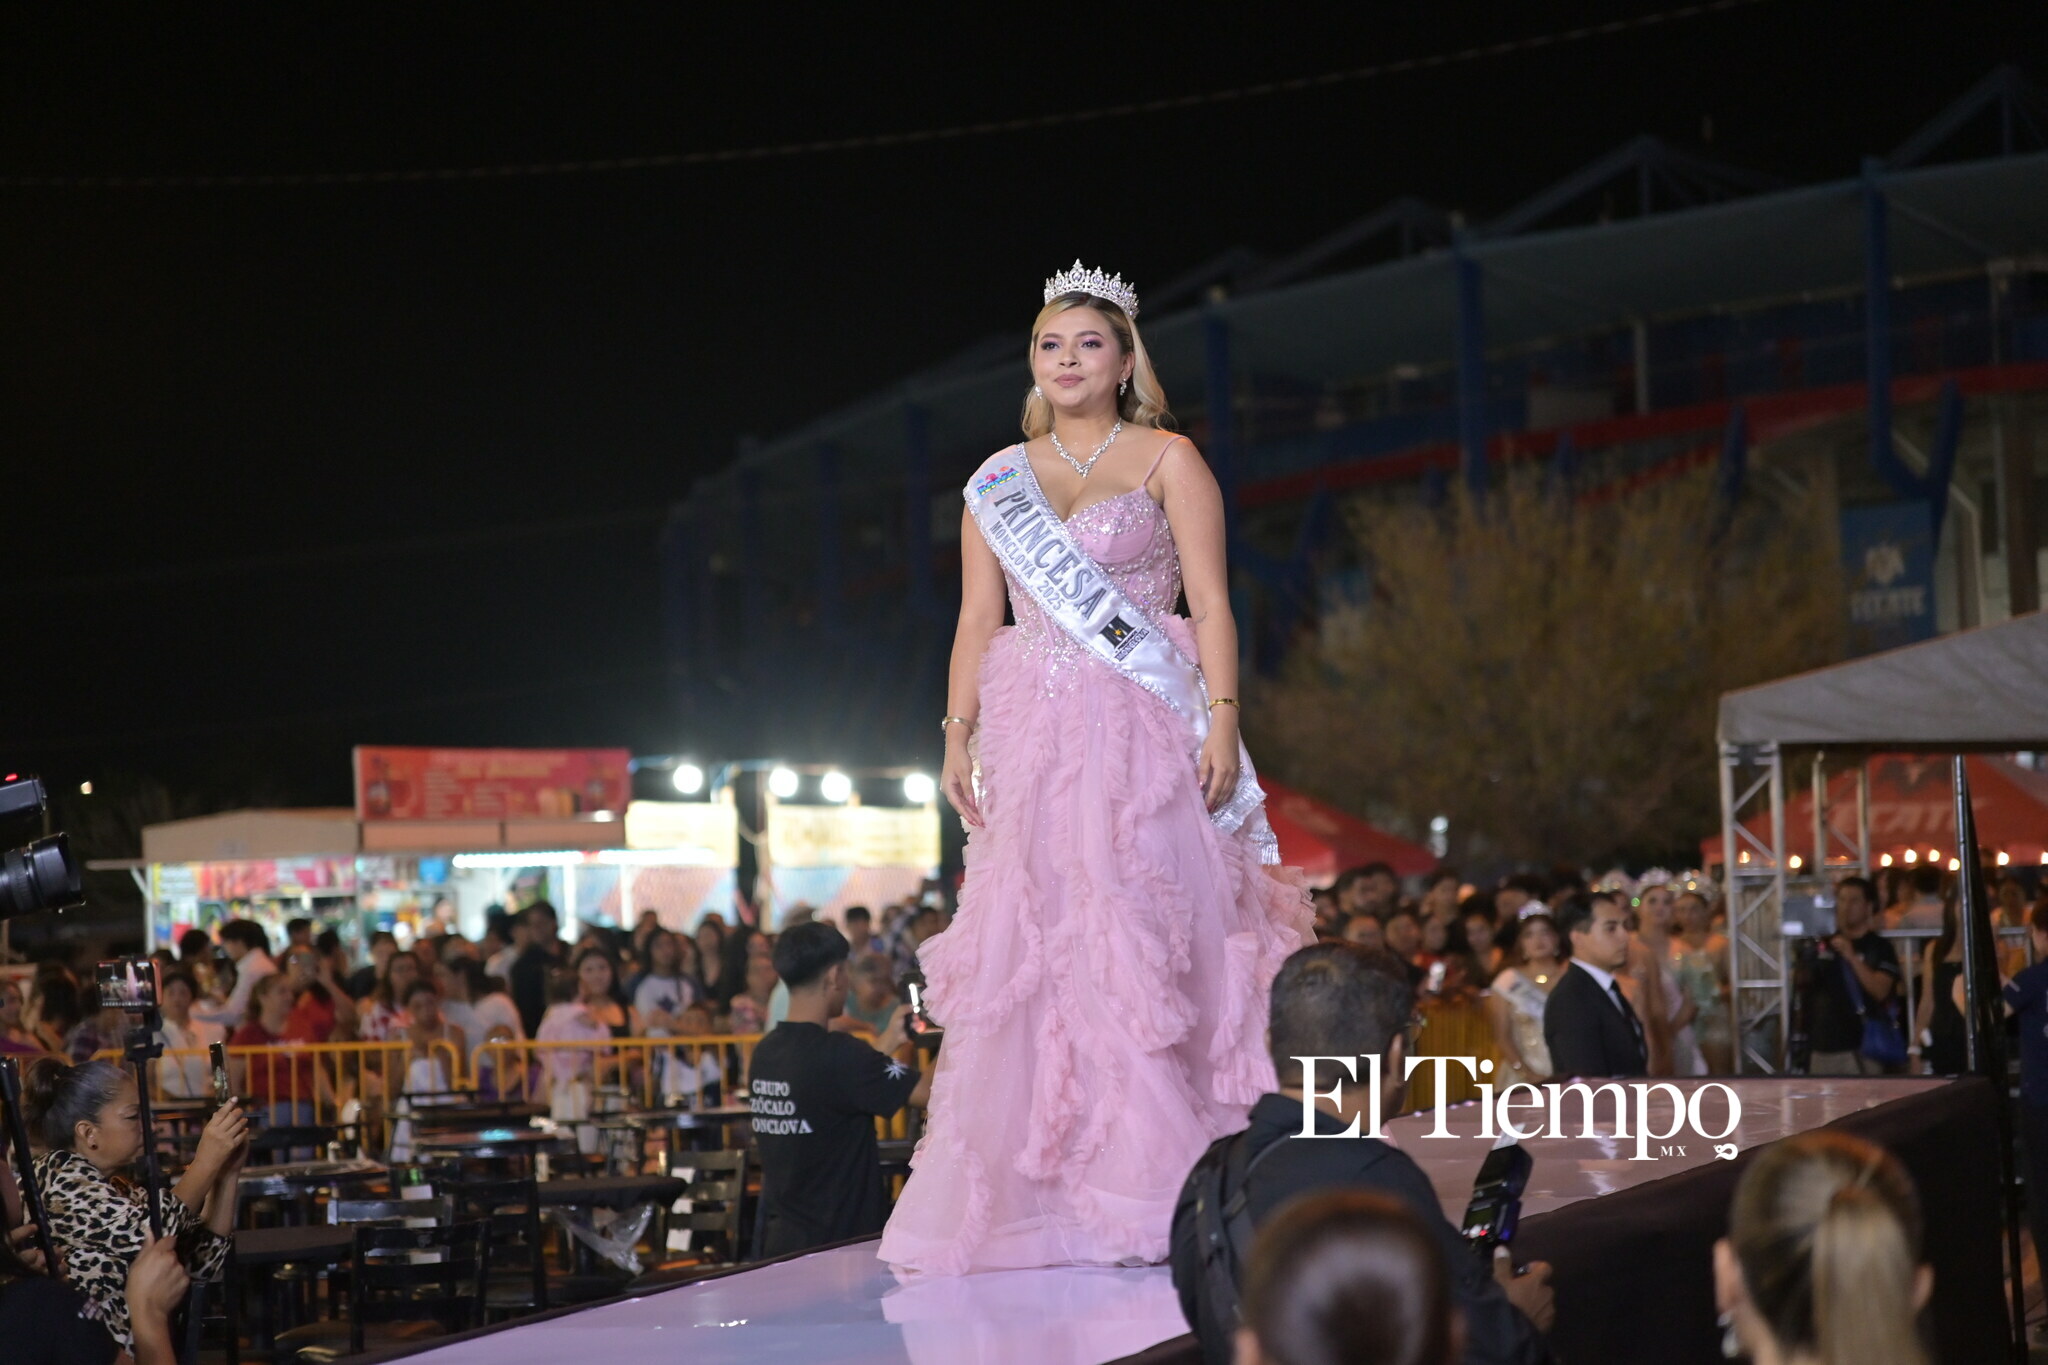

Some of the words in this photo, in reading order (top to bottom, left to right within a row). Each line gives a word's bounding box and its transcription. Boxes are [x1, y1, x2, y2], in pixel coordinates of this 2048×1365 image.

[993, 487, 1108, 621] PRINCESA
[988, 519, 1037, 580] MONCLOVA
[1036, 579, 1066, 611] 2025
[752, 1079, 791, 1097] GRUPO
[750, 1096, 796, 1116] ZÓCALO
[751, 1118, 813, 1135] ONCLOVA
